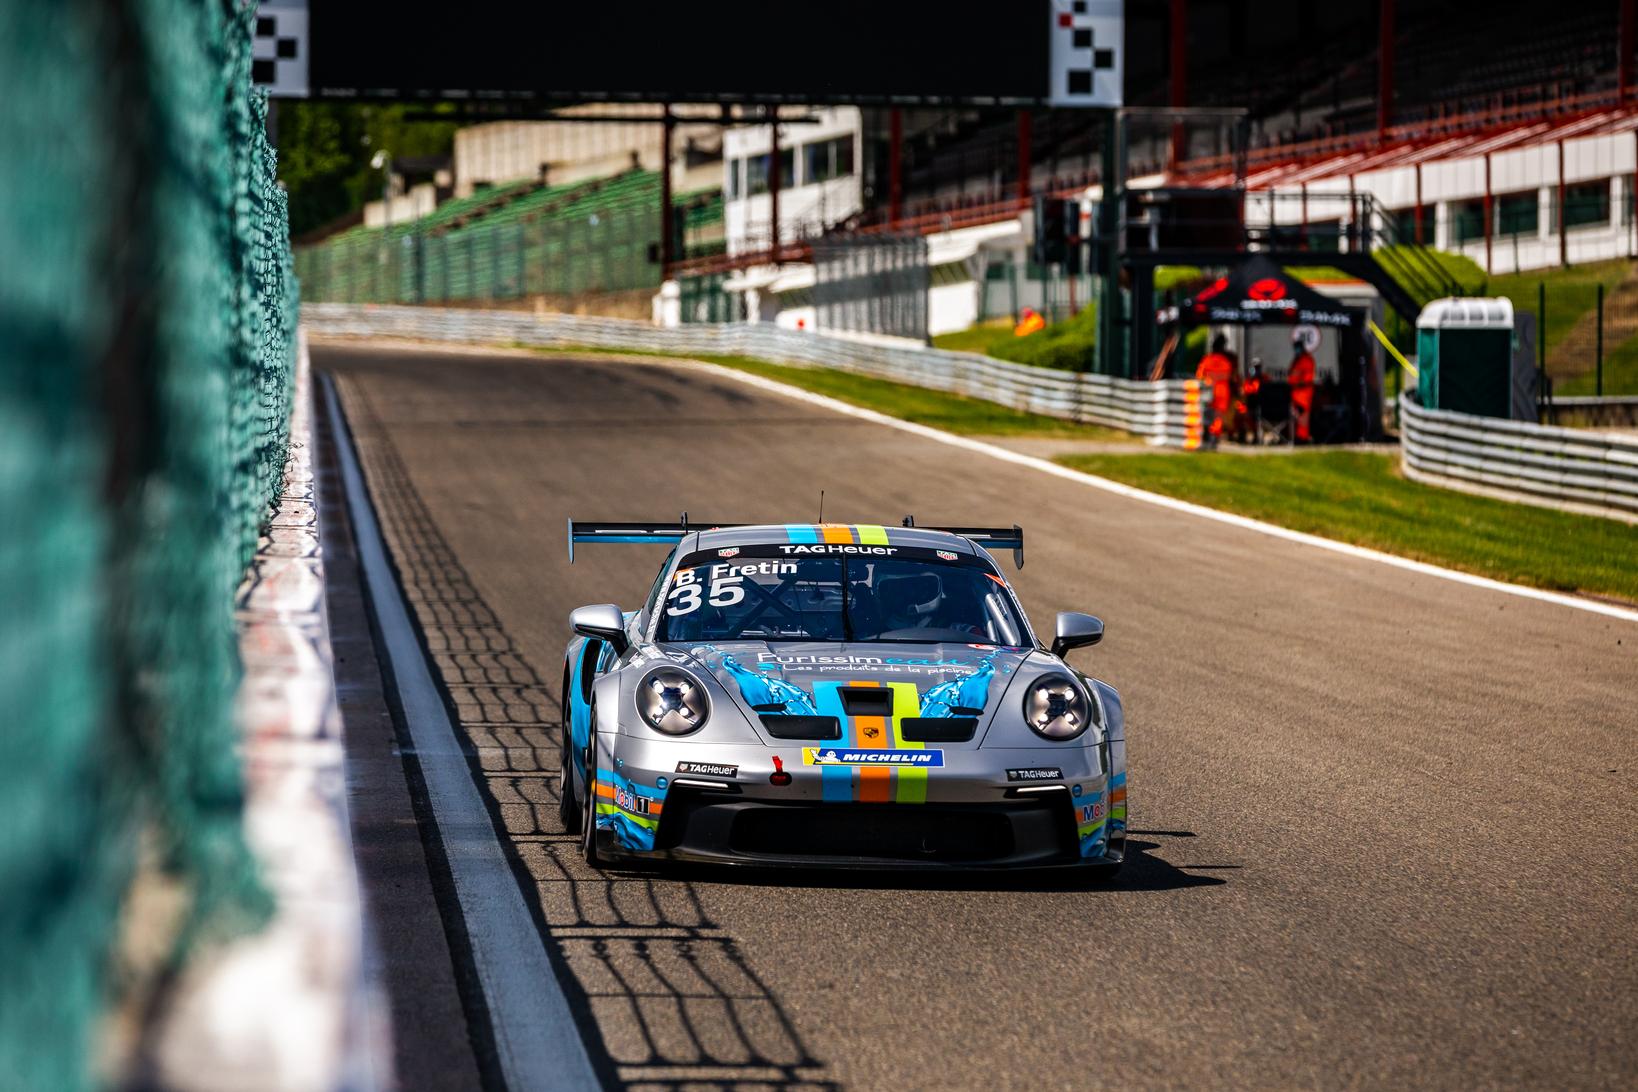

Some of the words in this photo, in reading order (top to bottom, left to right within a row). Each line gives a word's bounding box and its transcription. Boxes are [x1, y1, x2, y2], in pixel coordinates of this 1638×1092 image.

[676, 570, 702, 588] B.
[711, 560, 798, 579] Fretin
[666, 576, 745, 616] 35
[819, 664, 878, 672] produits
[842, 753, 932, 763] MICHELIN
